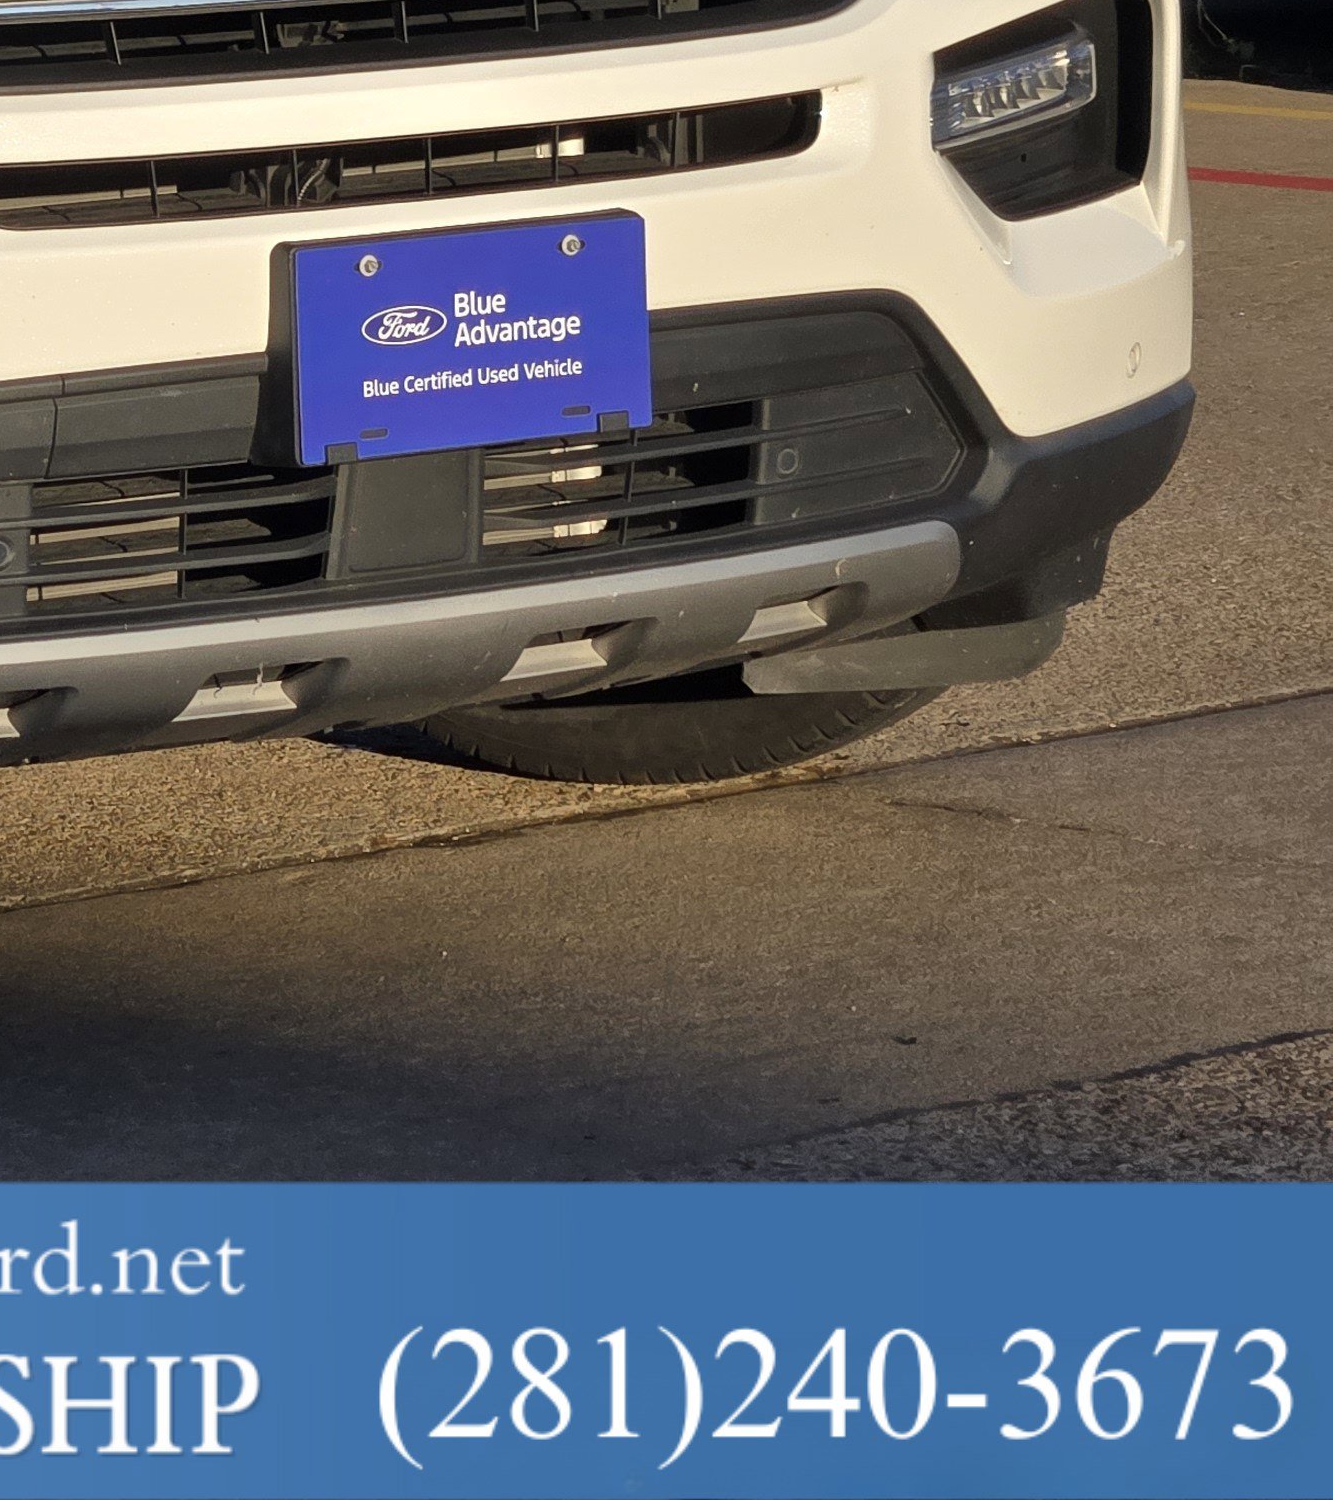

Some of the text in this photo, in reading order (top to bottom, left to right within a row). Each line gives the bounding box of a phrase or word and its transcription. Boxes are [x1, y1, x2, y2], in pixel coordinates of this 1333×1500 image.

[378, 291, 506, 340] Ford Blue
[454, 314, 581, 348] Advantage
[363, 358, 583, 398] Blue Certified Used Vehicle
